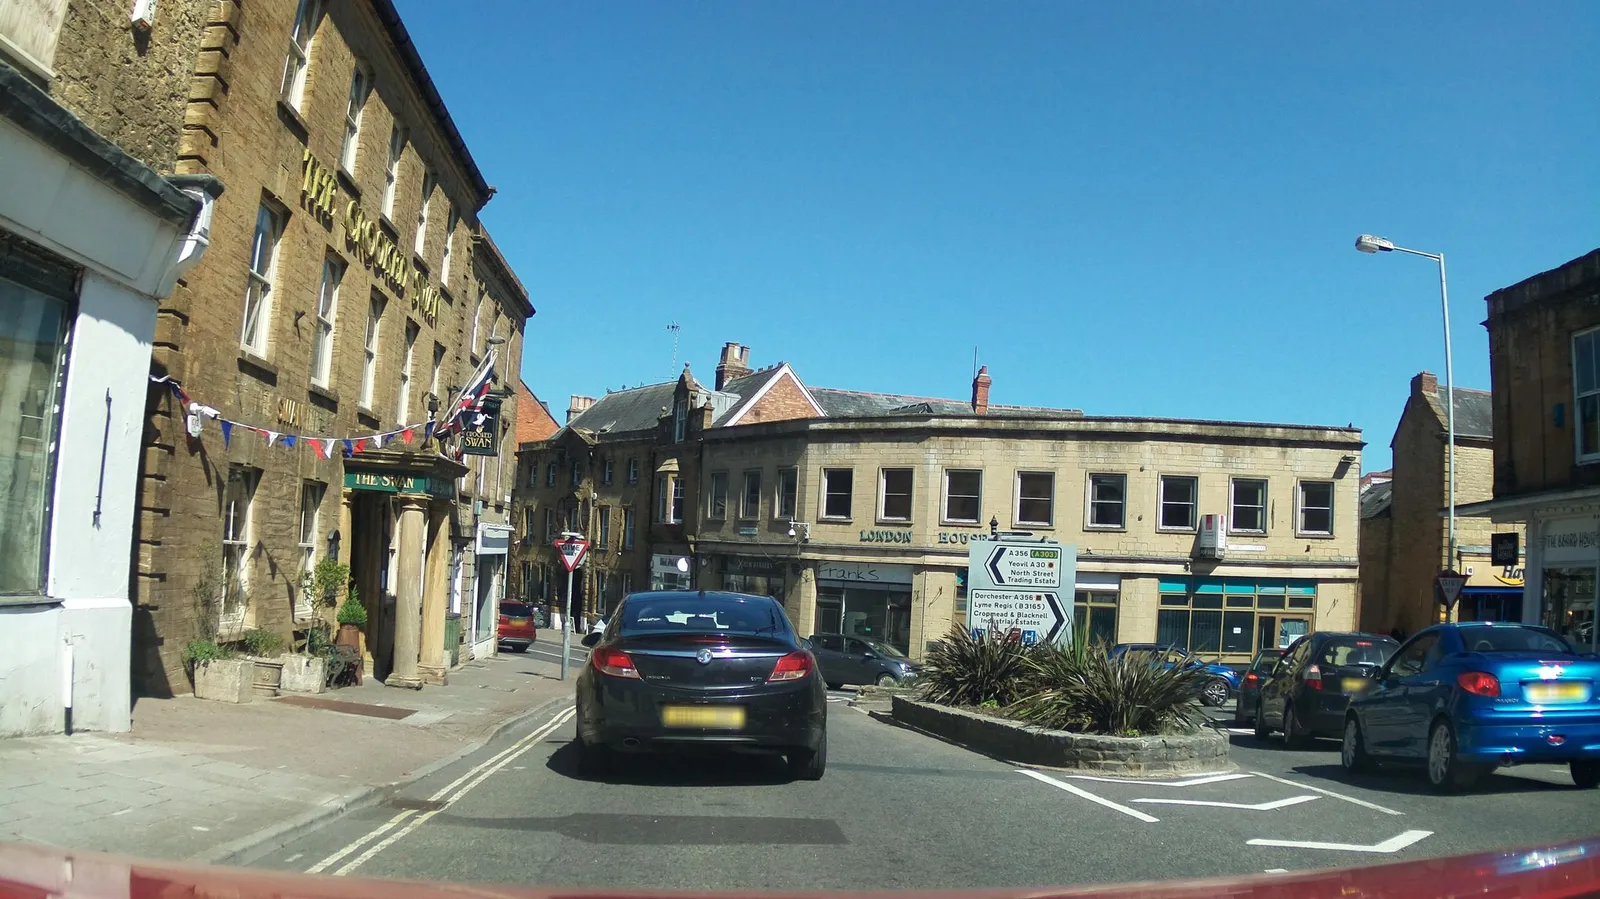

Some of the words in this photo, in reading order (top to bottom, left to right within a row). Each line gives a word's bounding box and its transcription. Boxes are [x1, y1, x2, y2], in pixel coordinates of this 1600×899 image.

[302, 148, 338, 217] THE
[346, 200, 409, 288] CROOKED
[465, 437, 492, 448] SWAN
[355, 472, 378, 485] THE
[382, 475, 414, 489] SWAN
[859, 530, 913, 543] LONDON
[1546, 535, 1557, 548] THE
[1031, 550, 1058, 558] (A303)
[818, 562, 880, 581] Frank's
[974, 592, 1012, 600] Dorchester
[994, 602, 1013, 610] Regis
[973, 610, 1008, 618] Cropmead
[1016, 611, 1048, 619] Blacknell
[1015, 618, 1041, 626] Estates
